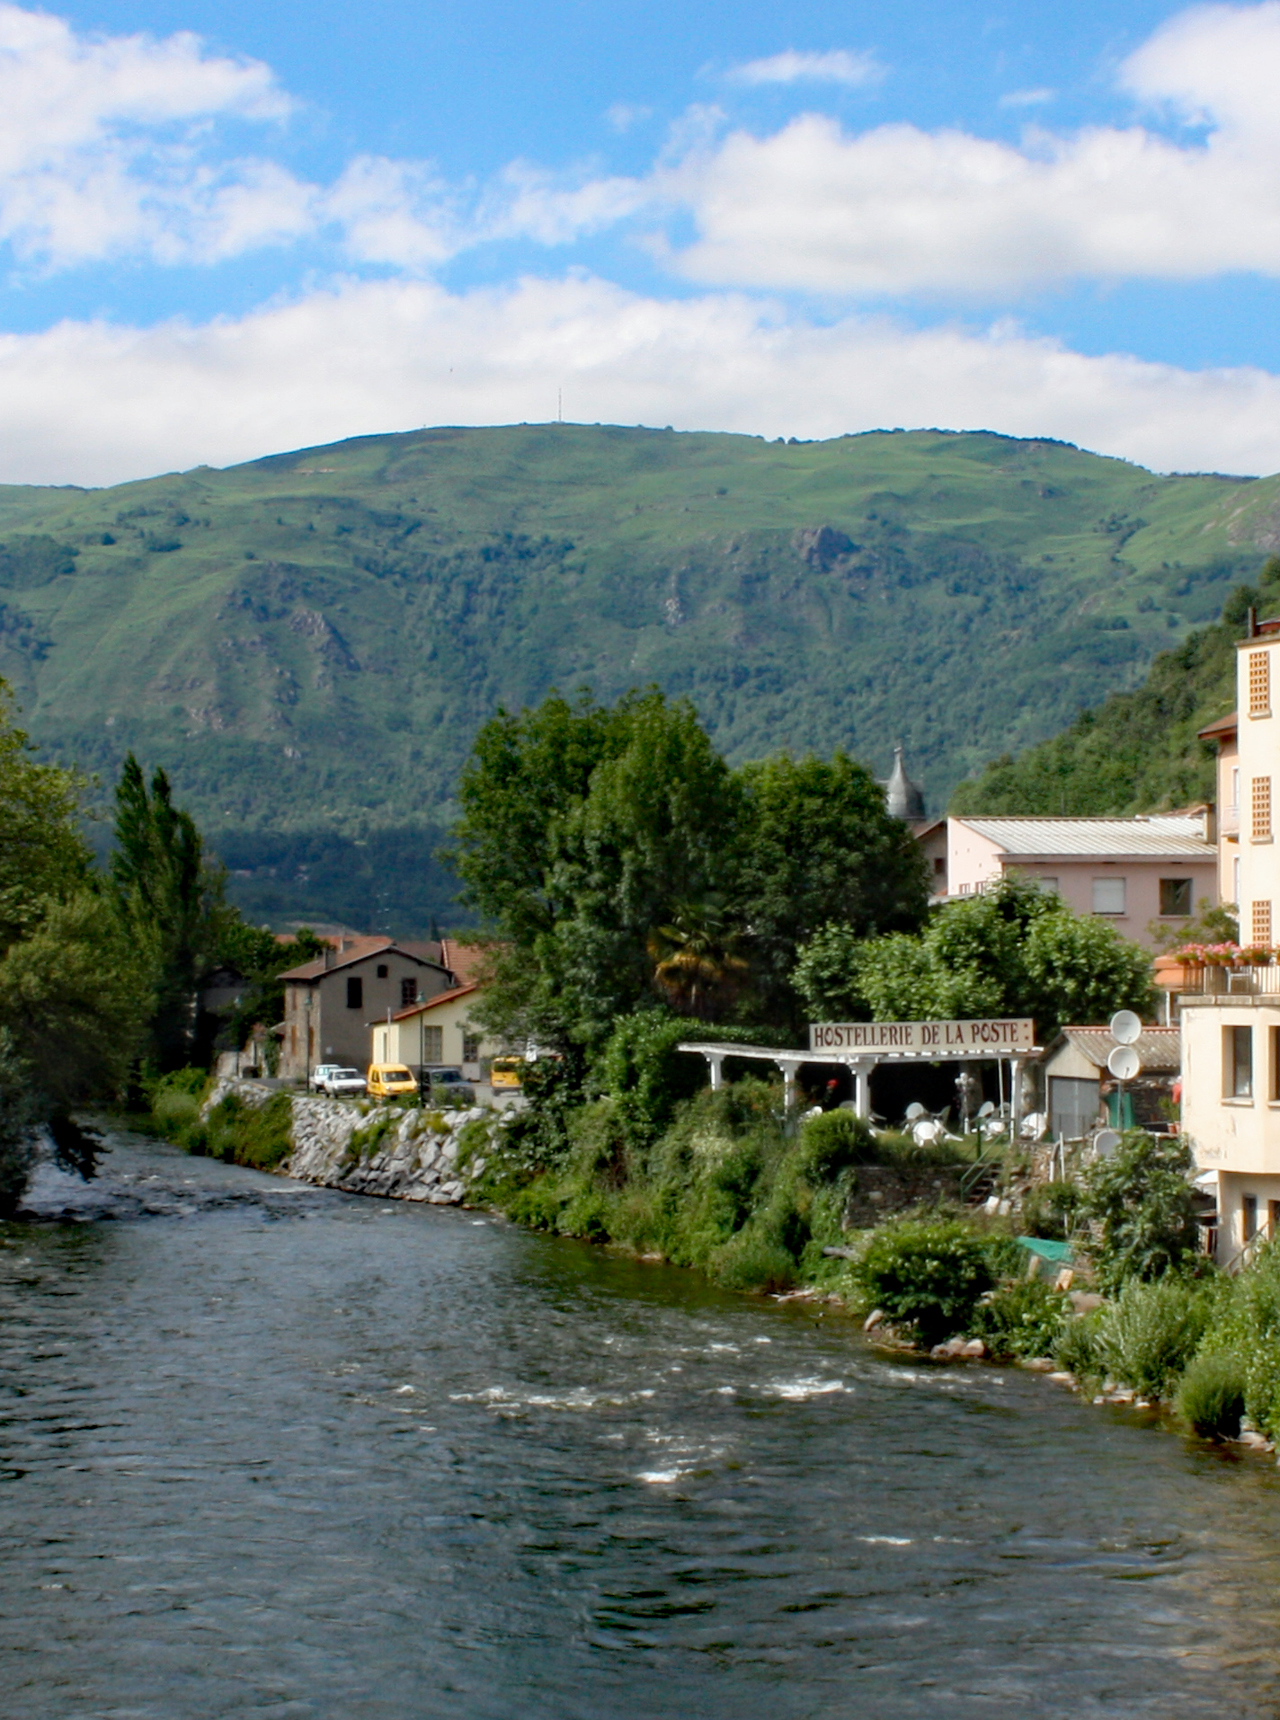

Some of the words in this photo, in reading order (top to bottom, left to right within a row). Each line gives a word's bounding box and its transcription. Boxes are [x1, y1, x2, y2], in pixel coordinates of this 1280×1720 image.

[814, 1025, 913, 1047] HOSTELLERIE
[921, 1025, 940, 1045] DE
[946, 1024, 964, 1044] LA
[971, 1022, 1019, 1043] POSTE
